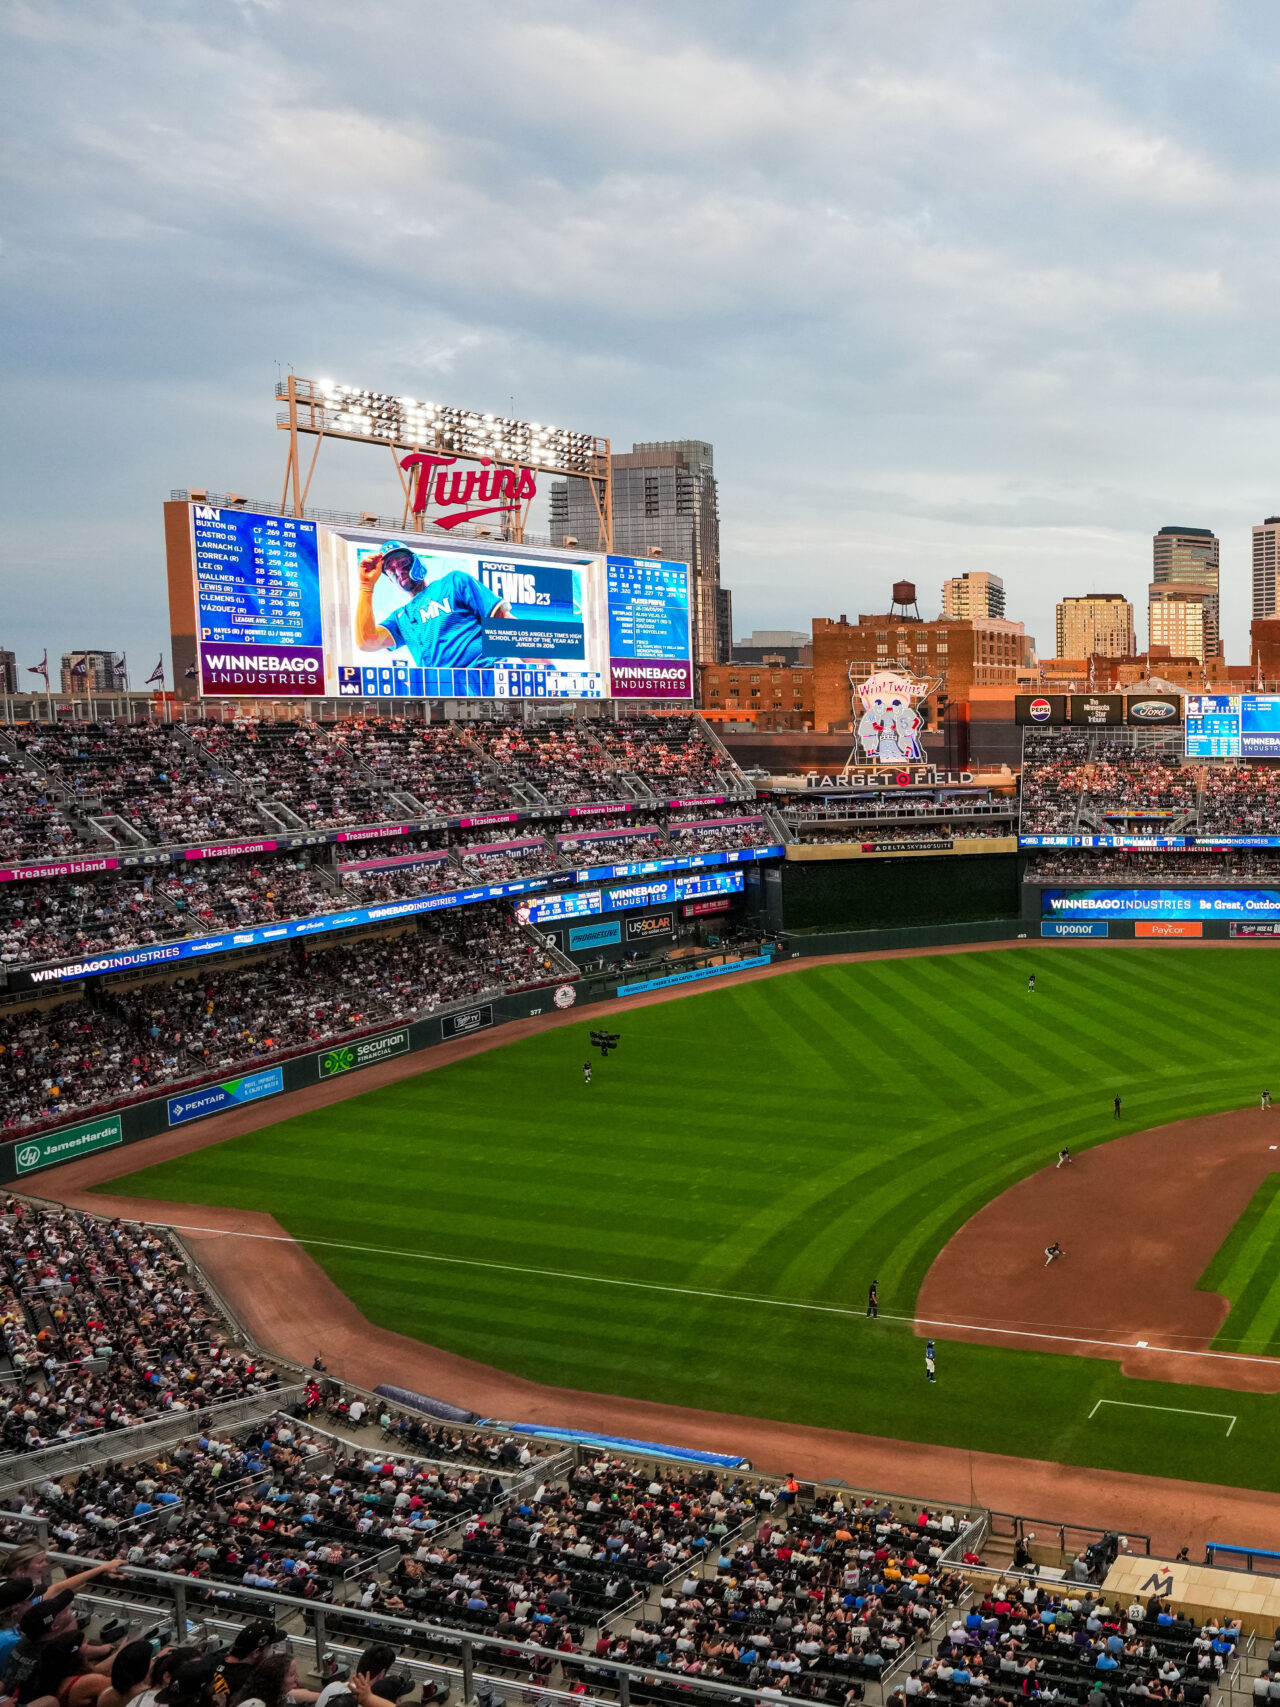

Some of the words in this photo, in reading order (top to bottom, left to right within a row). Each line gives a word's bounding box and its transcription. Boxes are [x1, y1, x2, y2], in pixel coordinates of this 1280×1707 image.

[400, 453, 537, 512] Twins
[195, 506, 221, 521] MN
[196, 519, 227, 530] BUXTON
[196, 531, 227, 540] CASTRO
[197, 541, 233, 551] LARNACH
[197, 552, 228, 561] CORREA
[198, 562, 213, 570] LEE
[482, 562, 516, 572] ROYCE
[199, 572, 235, 582] WALLNER
[199, 583, 223, 591] LEWIS
[200, 593, 235, 603] CLEMENS
[536, 593, 551, 606] 23
[200, 603, 236, 613] VÁZQUEZ
[419, 597, 454, 623] MN
[202, 627, 212, 640] P
[205, 654, 319, 672] WINNEBAGO
[211, 672, 317, 684] INDUSTRIES
[343, 668, 355, 681] P
[511, 672, 518, 682] 3
[537, 673, 543, 683] 5
[611, 667, 687, 680] WINNEBAGO
[340, 683, 360, 695] MN
[615, 680, 686, 689] INDUSTRIES
[888, 680, 926, 695] Twins!
[1229, 697, 1239, 706] 30
[1139, 704, 1167, 716] Ford
[809, 773, 893, 787] TARGET
[914, 772, 974, 784] FIELD
[678, 798, 716, 807] TIcasino.com
[575, 806, 605, 815] Treasure
[606, 804, 626, 813] Island
[470, 815, 510, 826] TIcasino.com
[344, 831, 379, 841] Treasure
[380, 827, 403, 838] Island
[200, 843, 264, 858] TIcasino.com
[11, 866, 67, 880] Treasure
[70, 860, 107, 873] Island
[609, 884, 668, 900] WINNEBAGO
[1199, 900, 1212, 910] Be
[1214, 899, 1244, 911] Great,
[572, 928, 619, 943] PROGRESSIVE
[1056, 925, 1093, 936] uponor
[1152, 925, 1184, 935] Paycor
[530, 1008, 542, 1016] 377
[357, 1034, 404, 1056] securian
[357, 1048, 391, 1062] FINANCIAL
[185, 1093, 225, 1111] PENTAIR
[43, 1127, 118, 1155] JamesHardie
[1131, 1609, 1140, 1618] 23
